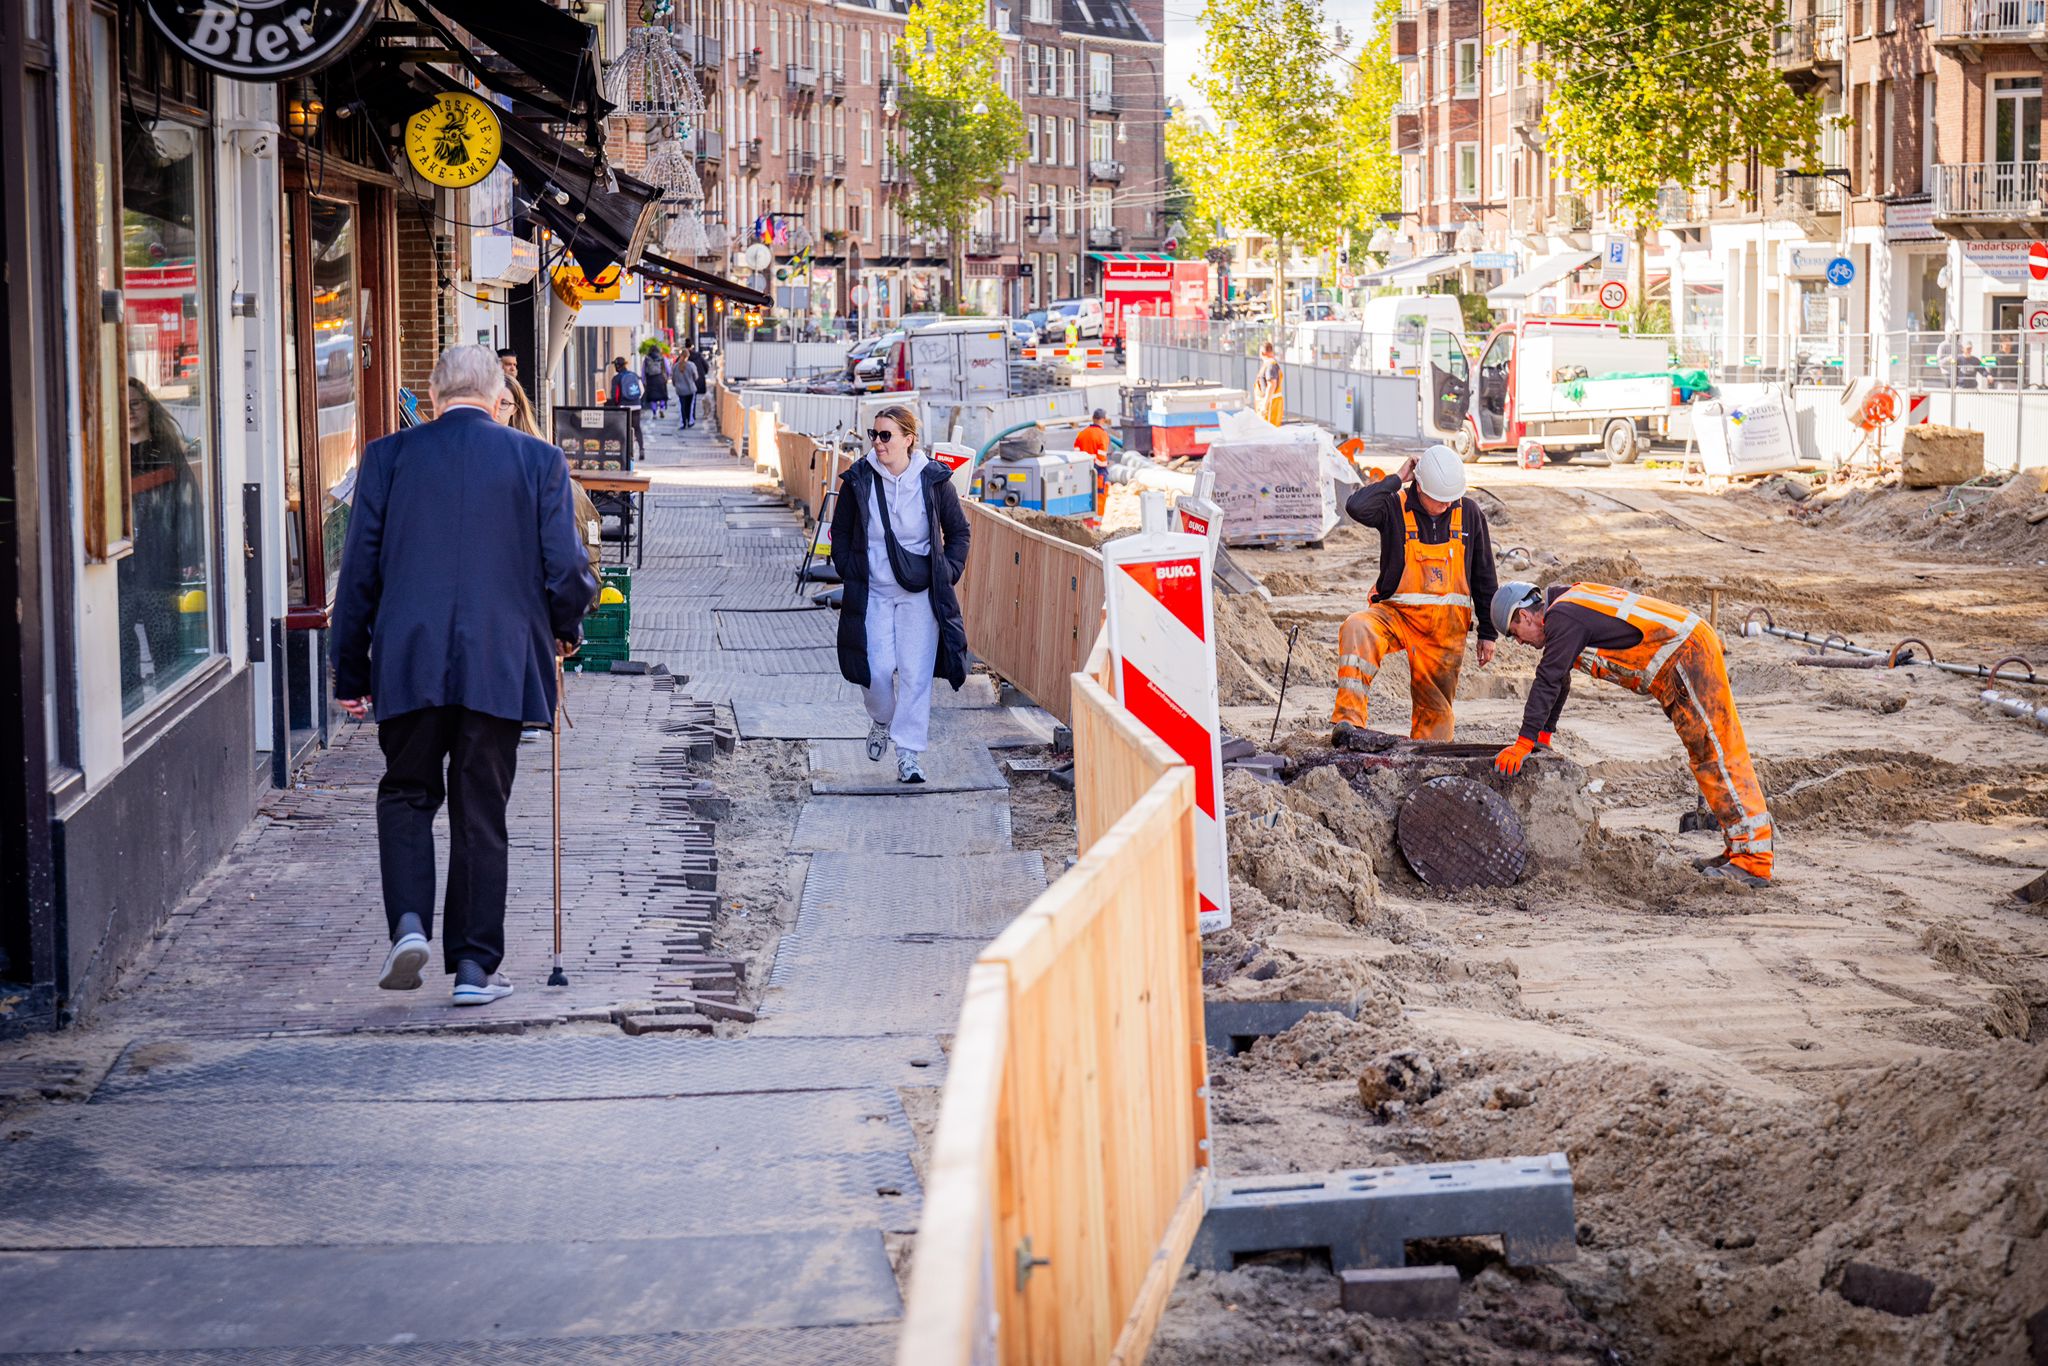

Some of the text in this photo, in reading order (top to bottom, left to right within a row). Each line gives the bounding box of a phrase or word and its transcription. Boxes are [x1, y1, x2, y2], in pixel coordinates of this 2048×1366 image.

[187, 0, 316, 63] Bier
[414, 99, 492, 134] ROTISSERIE
[414, 146, 492, 180] TAKE-AWAY
[1966, 241, 2048, 252] Tandartsprak
[1604, 289, 1623, 302] 30
[1747, 403, 1779, 417] Grute
[1188, 520, 1206, 533] BUKO.
[1155, 564, 1196, 579] BUKO.
